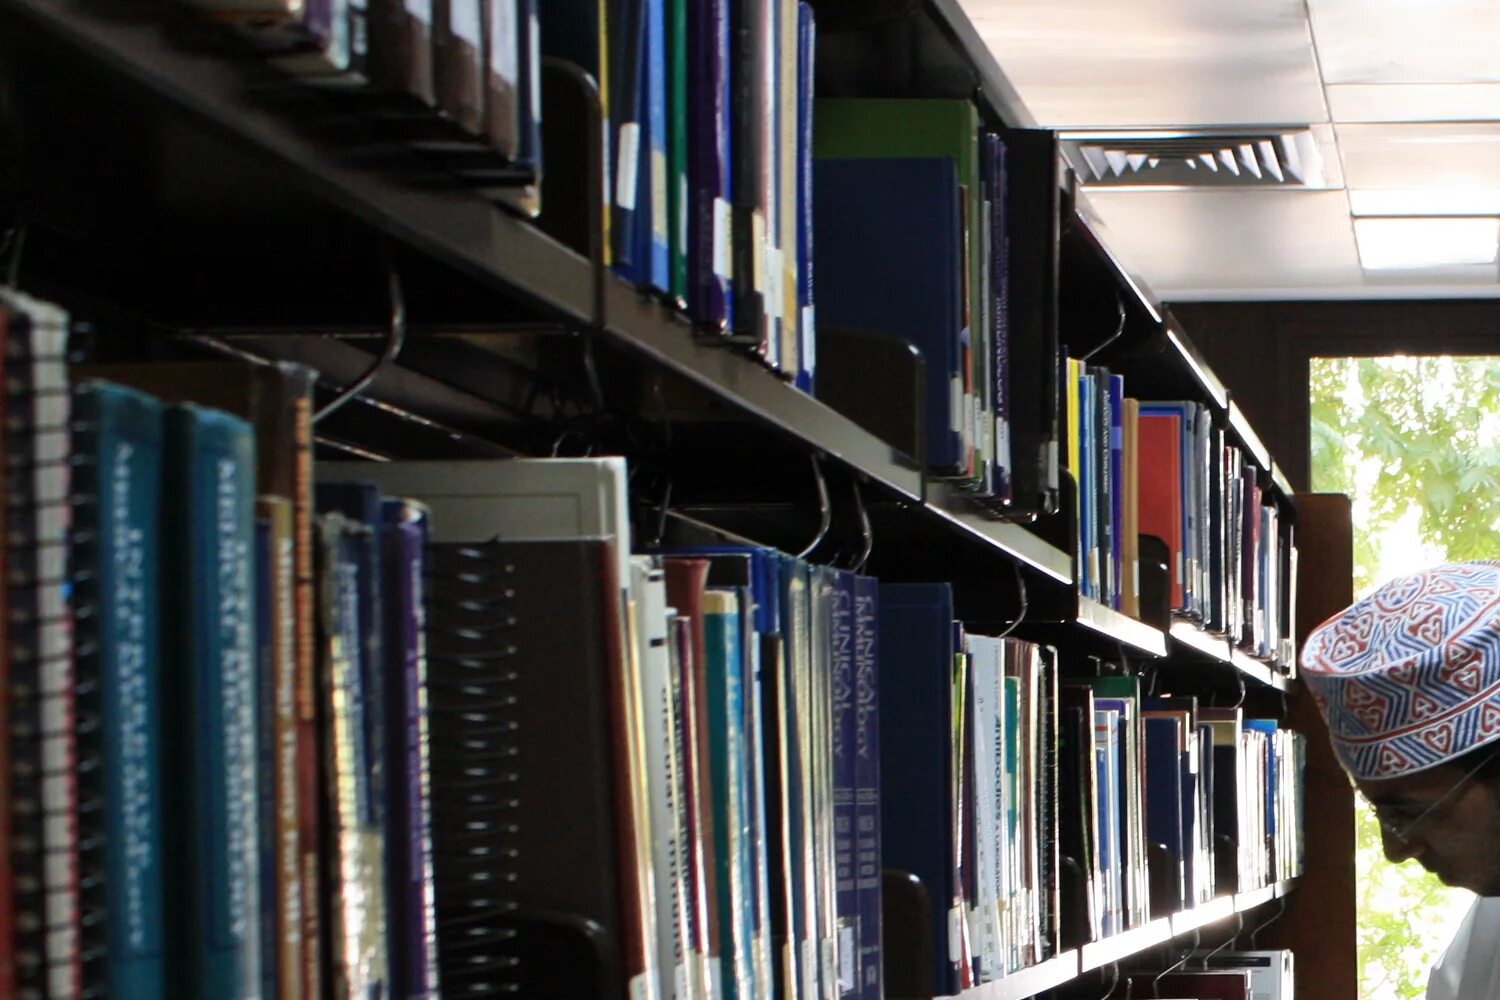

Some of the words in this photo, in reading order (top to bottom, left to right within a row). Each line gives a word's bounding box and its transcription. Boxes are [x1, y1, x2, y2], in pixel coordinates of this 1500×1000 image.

[832, 588, 846, 760] IMMUNOLOGY
[841, 588, 853, 710] CLINICAL
[855, 595, 869, 760] IMMUNOLOGY
[864, 594, 877, 714] CLINICAL
